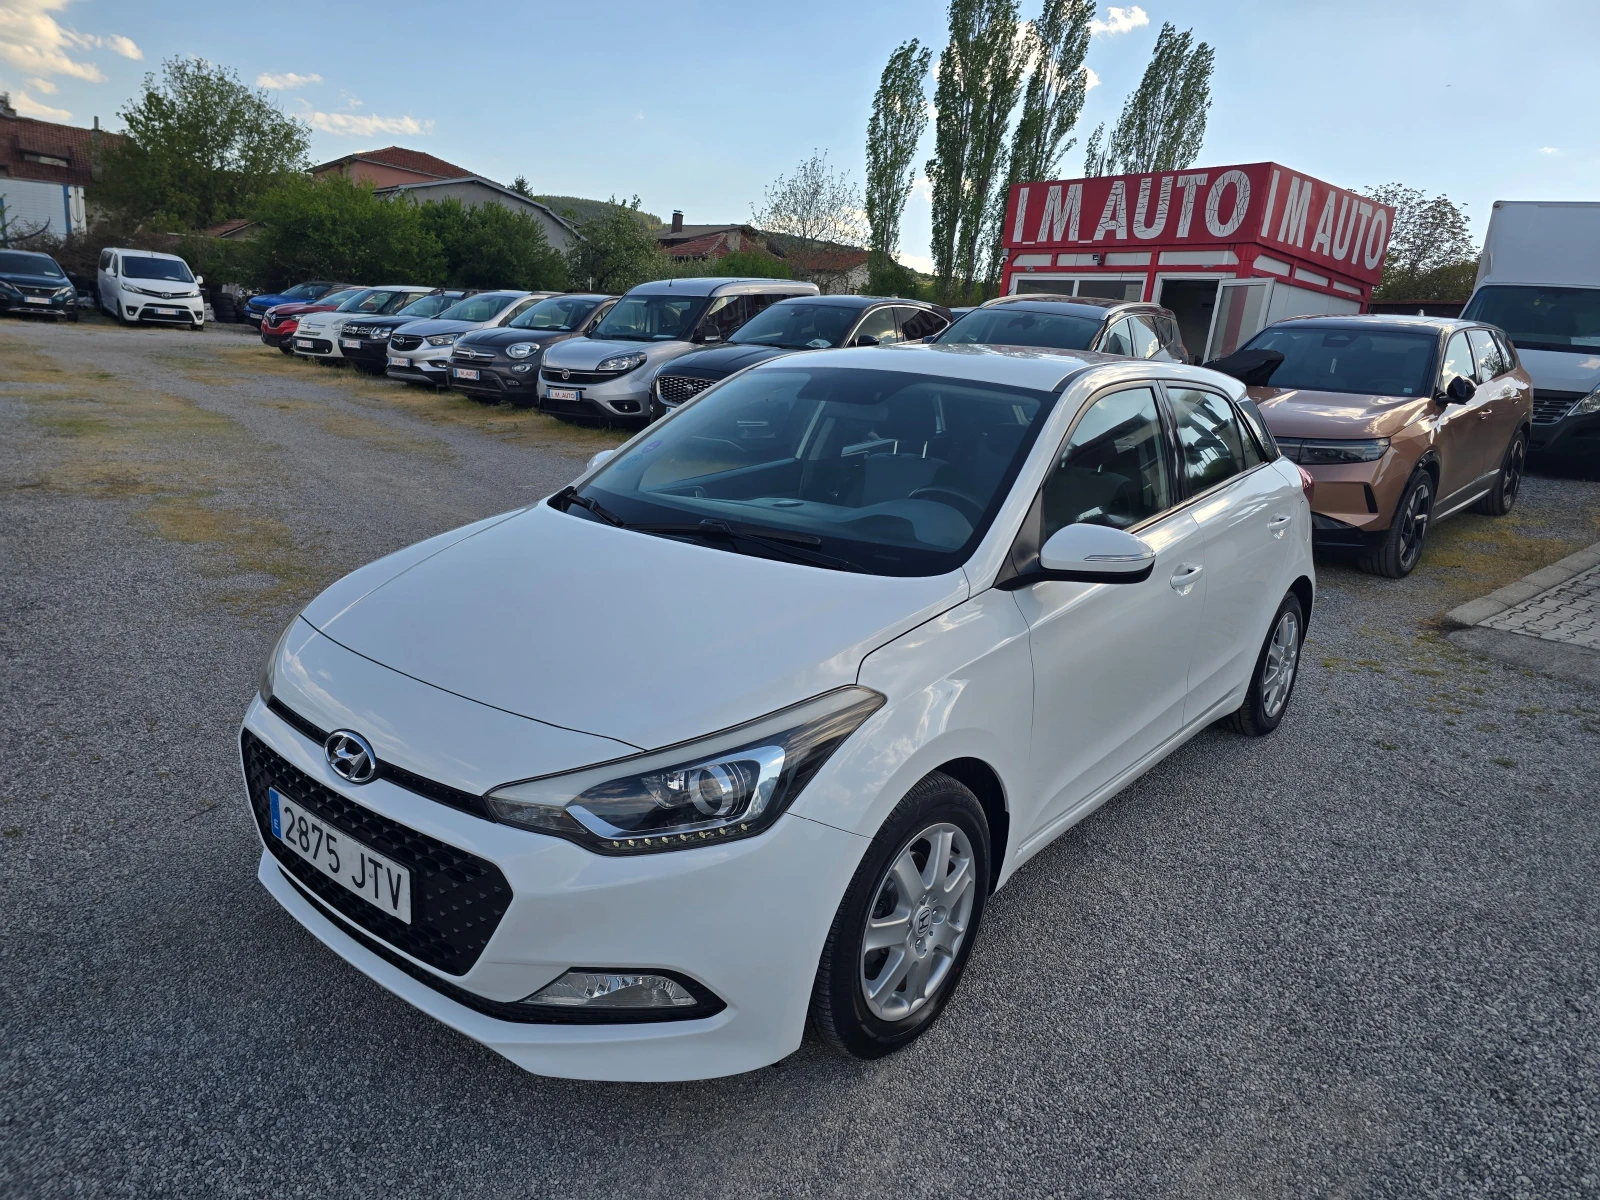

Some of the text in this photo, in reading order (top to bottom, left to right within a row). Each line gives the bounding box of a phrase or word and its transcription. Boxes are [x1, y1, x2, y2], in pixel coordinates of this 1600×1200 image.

[1260, 169, 1387, 270] I M AUTO
[274, 807, 401, 910] E 2875 JTV
